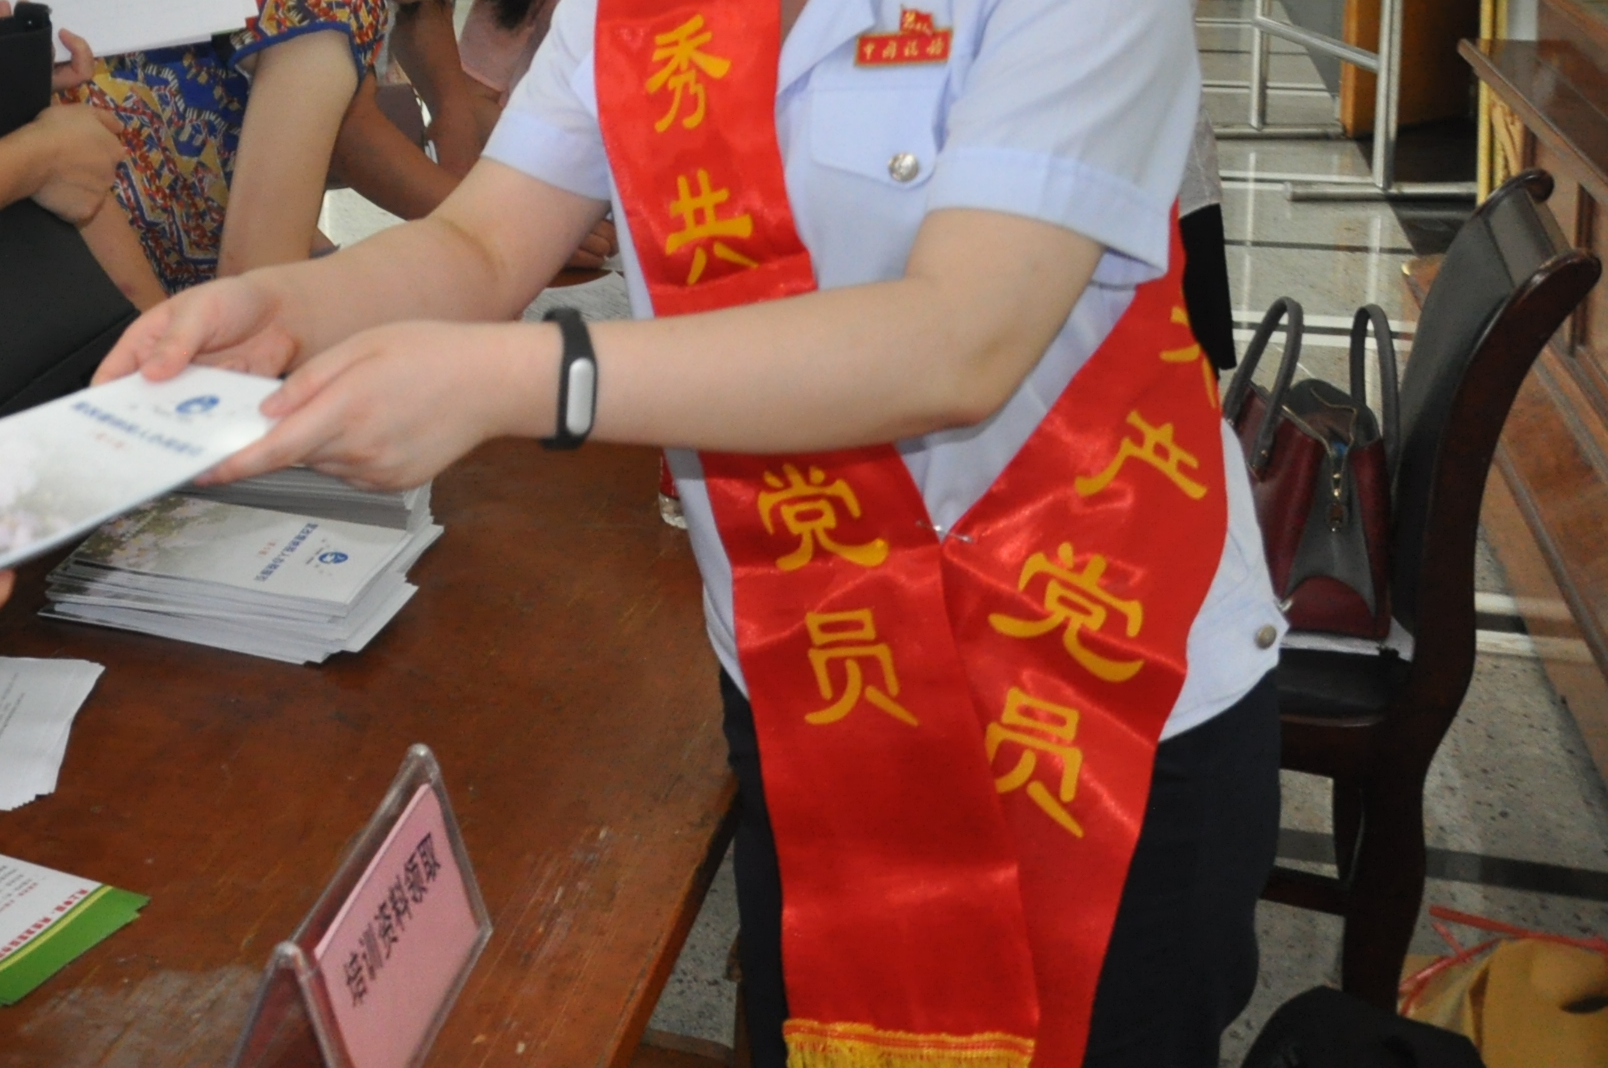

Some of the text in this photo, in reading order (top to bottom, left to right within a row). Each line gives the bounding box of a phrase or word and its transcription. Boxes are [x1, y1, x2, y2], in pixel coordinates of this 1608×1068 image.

[342, 831, 442, 1008] 培训资料领取
